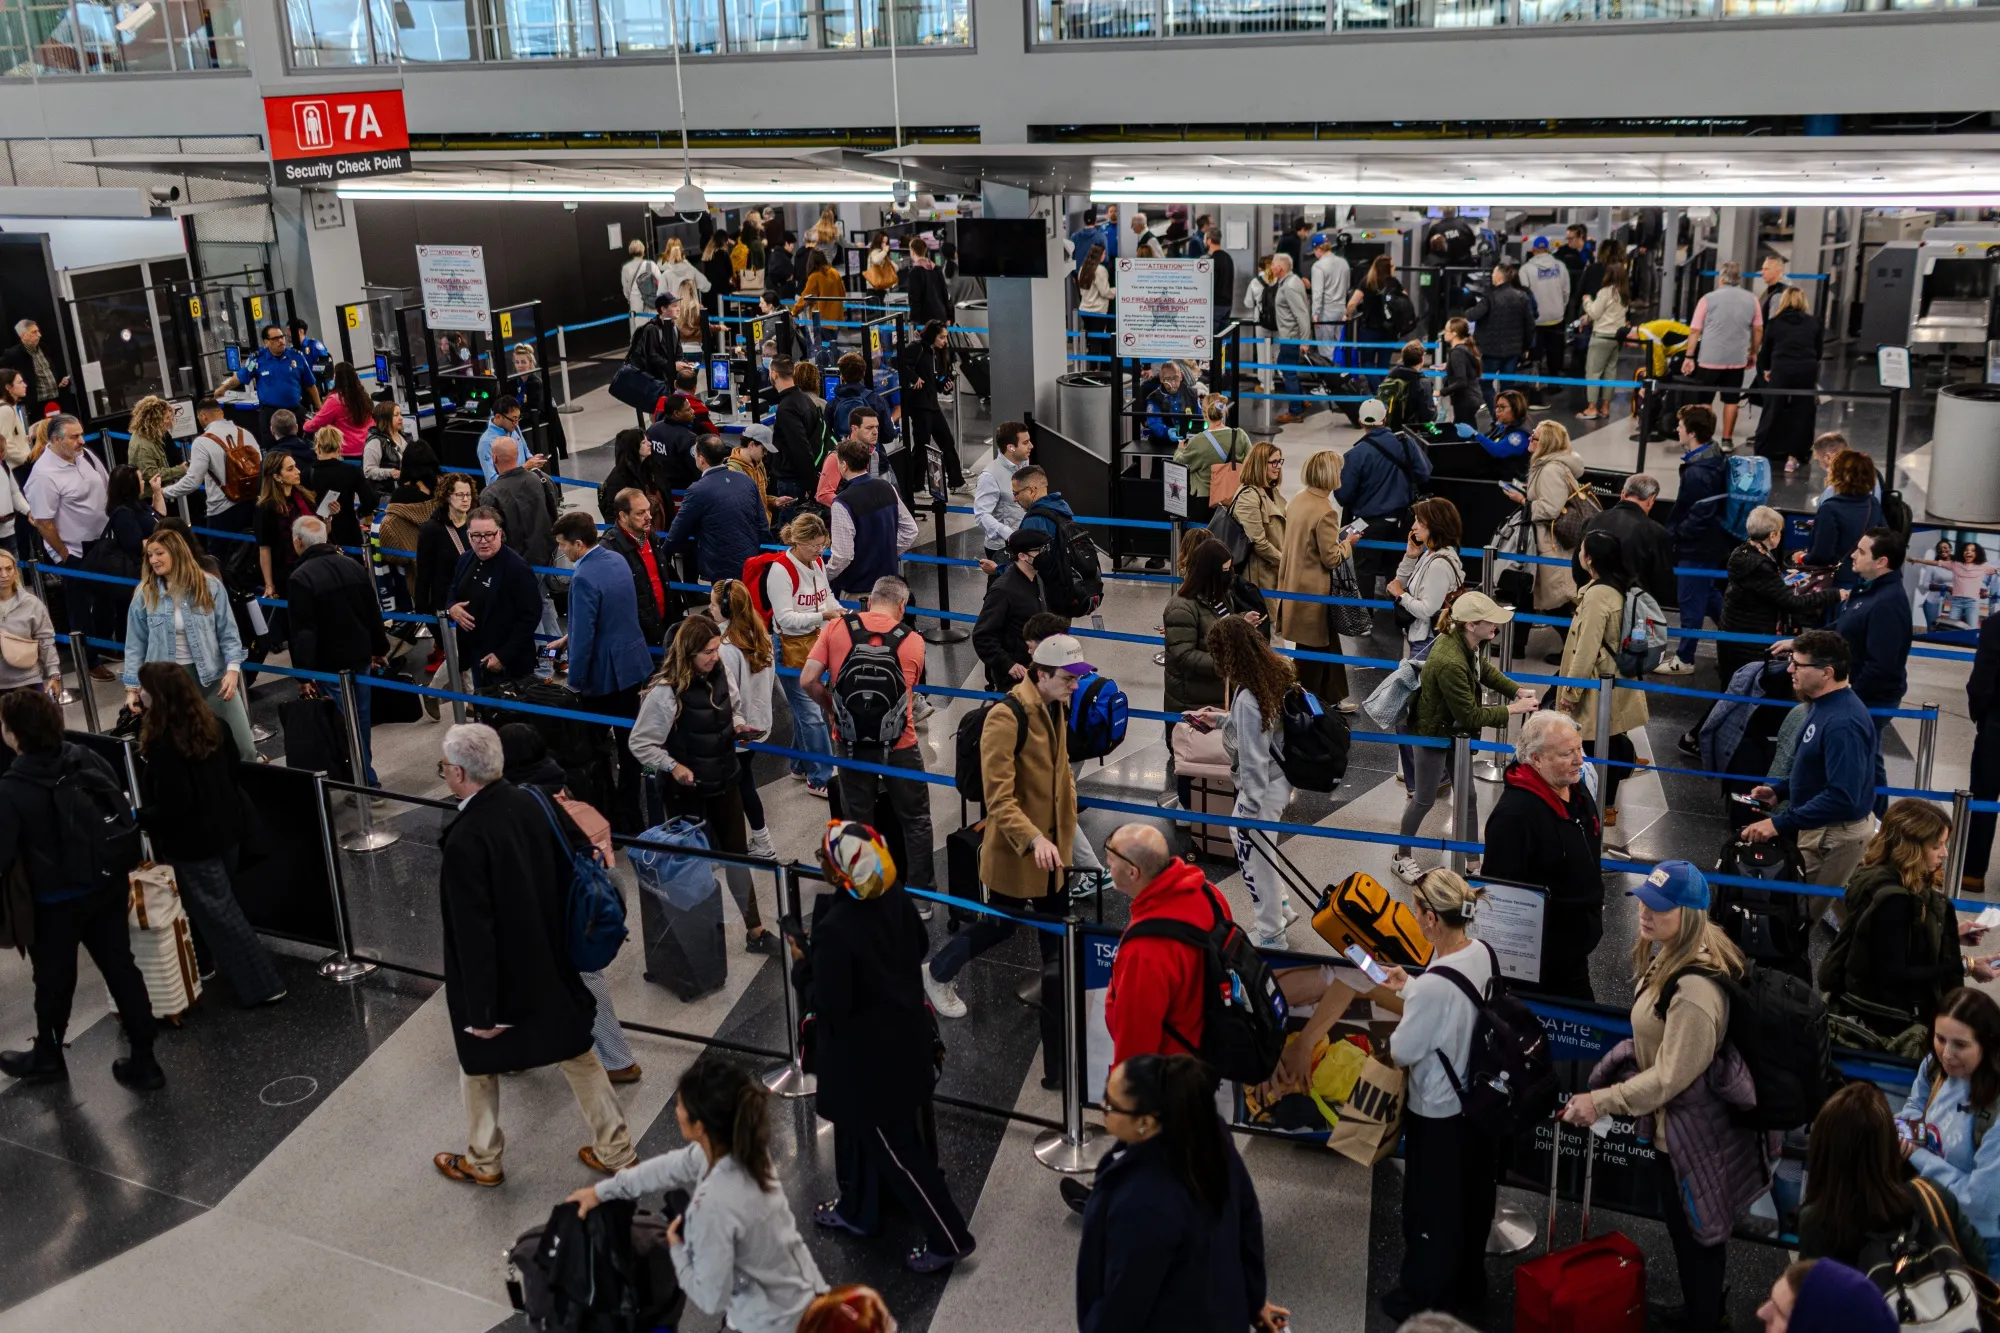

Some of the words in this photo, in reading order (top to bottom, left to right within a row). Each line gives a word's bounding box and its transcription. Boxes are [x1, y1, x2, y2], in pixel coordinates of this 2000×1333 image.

[337, 103, 383, 140] 7A
[285, 163, 333, 179] Security
[336, 158, 372, 174] Check
[373, 155, 402, 170] Point
[192, 301, 199, 314] 6
[253, 303, 261, 318] 6
[348, 313, 357, 328] 5
[503, 320, 510, 335] 4
[754, 323, 761, 339] 3
[872, 332, 878, 348] 2
[651, 440, 668, 456] TSA
[1093, 942, 1118, 959] TSA
[1557, 1034, 1579, 1046] With
[1580, 1038, 1601, 1050] Ease
[1535, 1126, 1582, 1145] Chidren
[1603, 1141, 1625, 1153] and
[1558, 1145, 1580, 1157] you
[1603, 1152, 1628, 1166] free.
